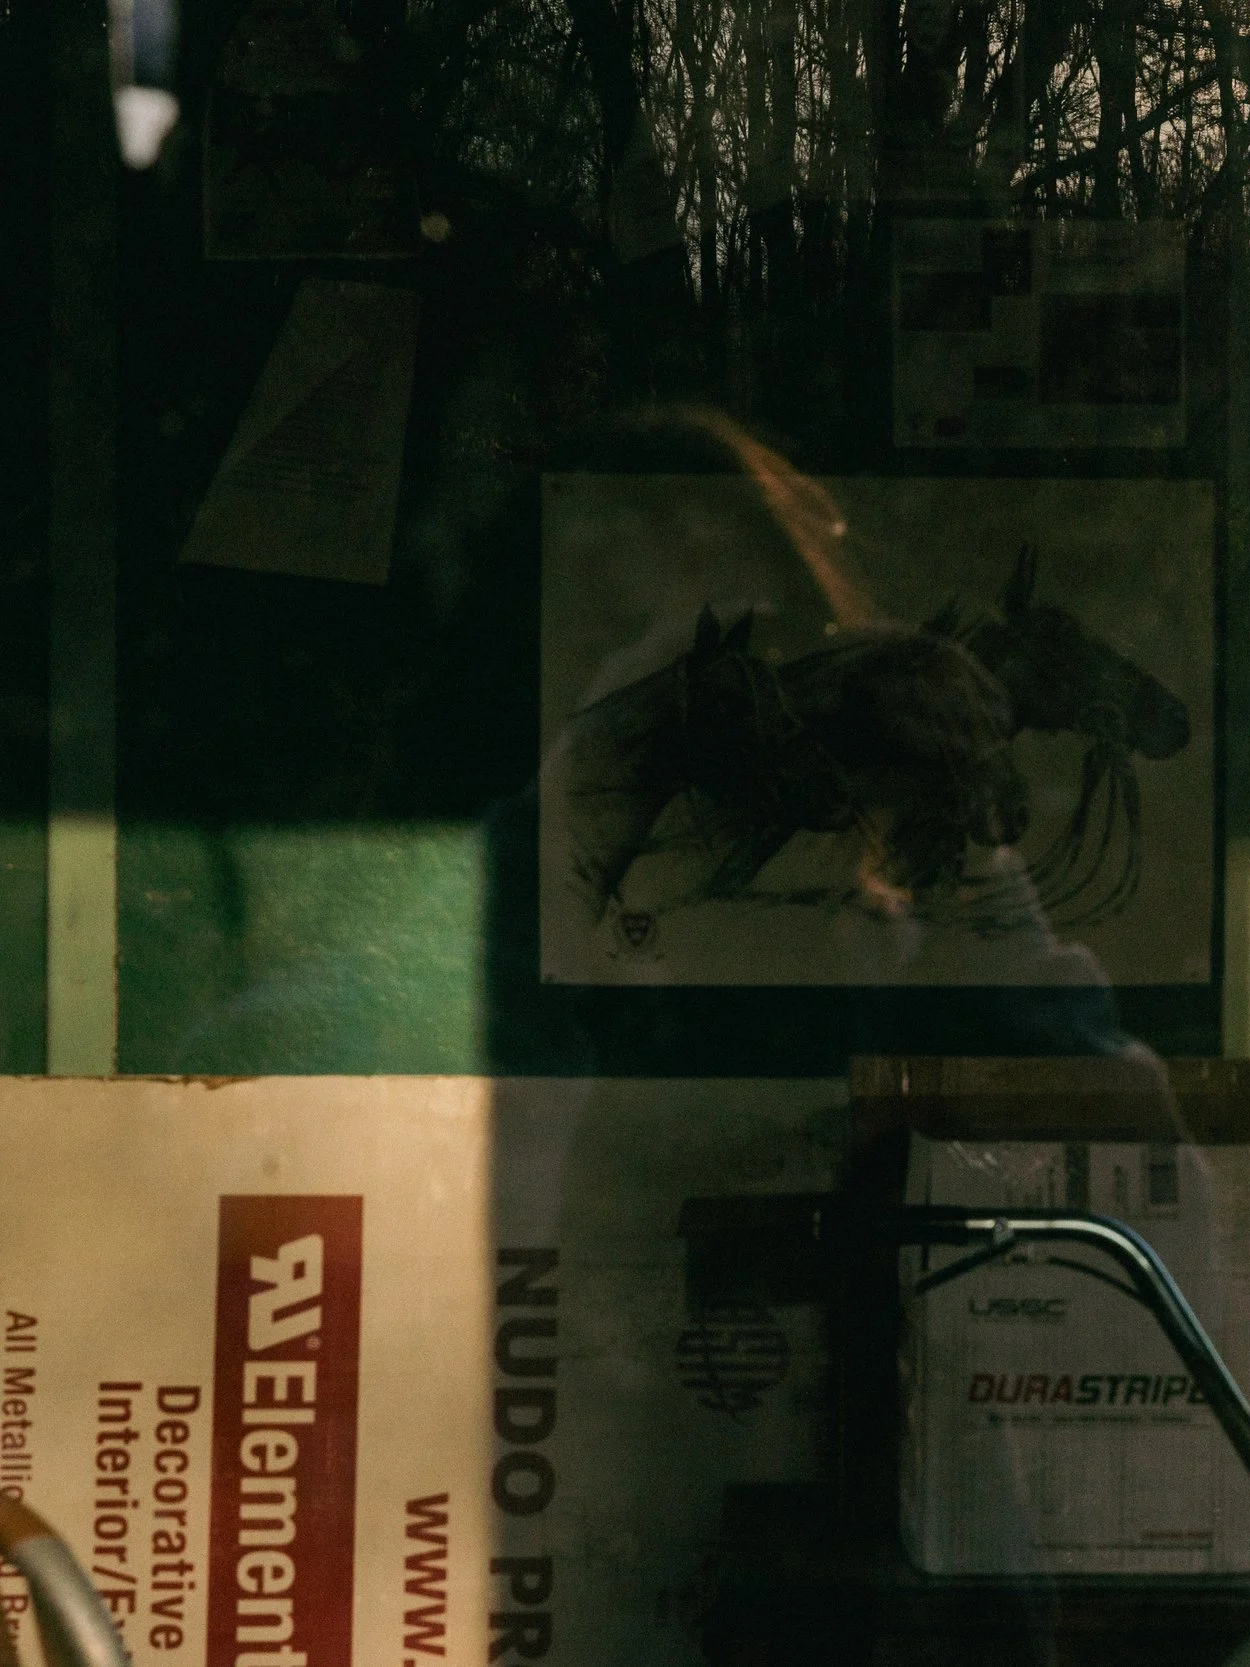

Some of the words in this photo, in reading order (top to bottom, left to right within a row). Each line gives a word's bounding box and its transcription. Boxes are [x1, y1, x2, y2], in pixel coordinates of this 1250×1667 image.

[5, 1311, 38, 1352] All
[490, 1247, 560, 1517] NUDO
[92, 1380, 143, 1662] Interior/E
[148, 1385, 201, 1651] Decorative
[485, 1556, 553, 1667] PR
